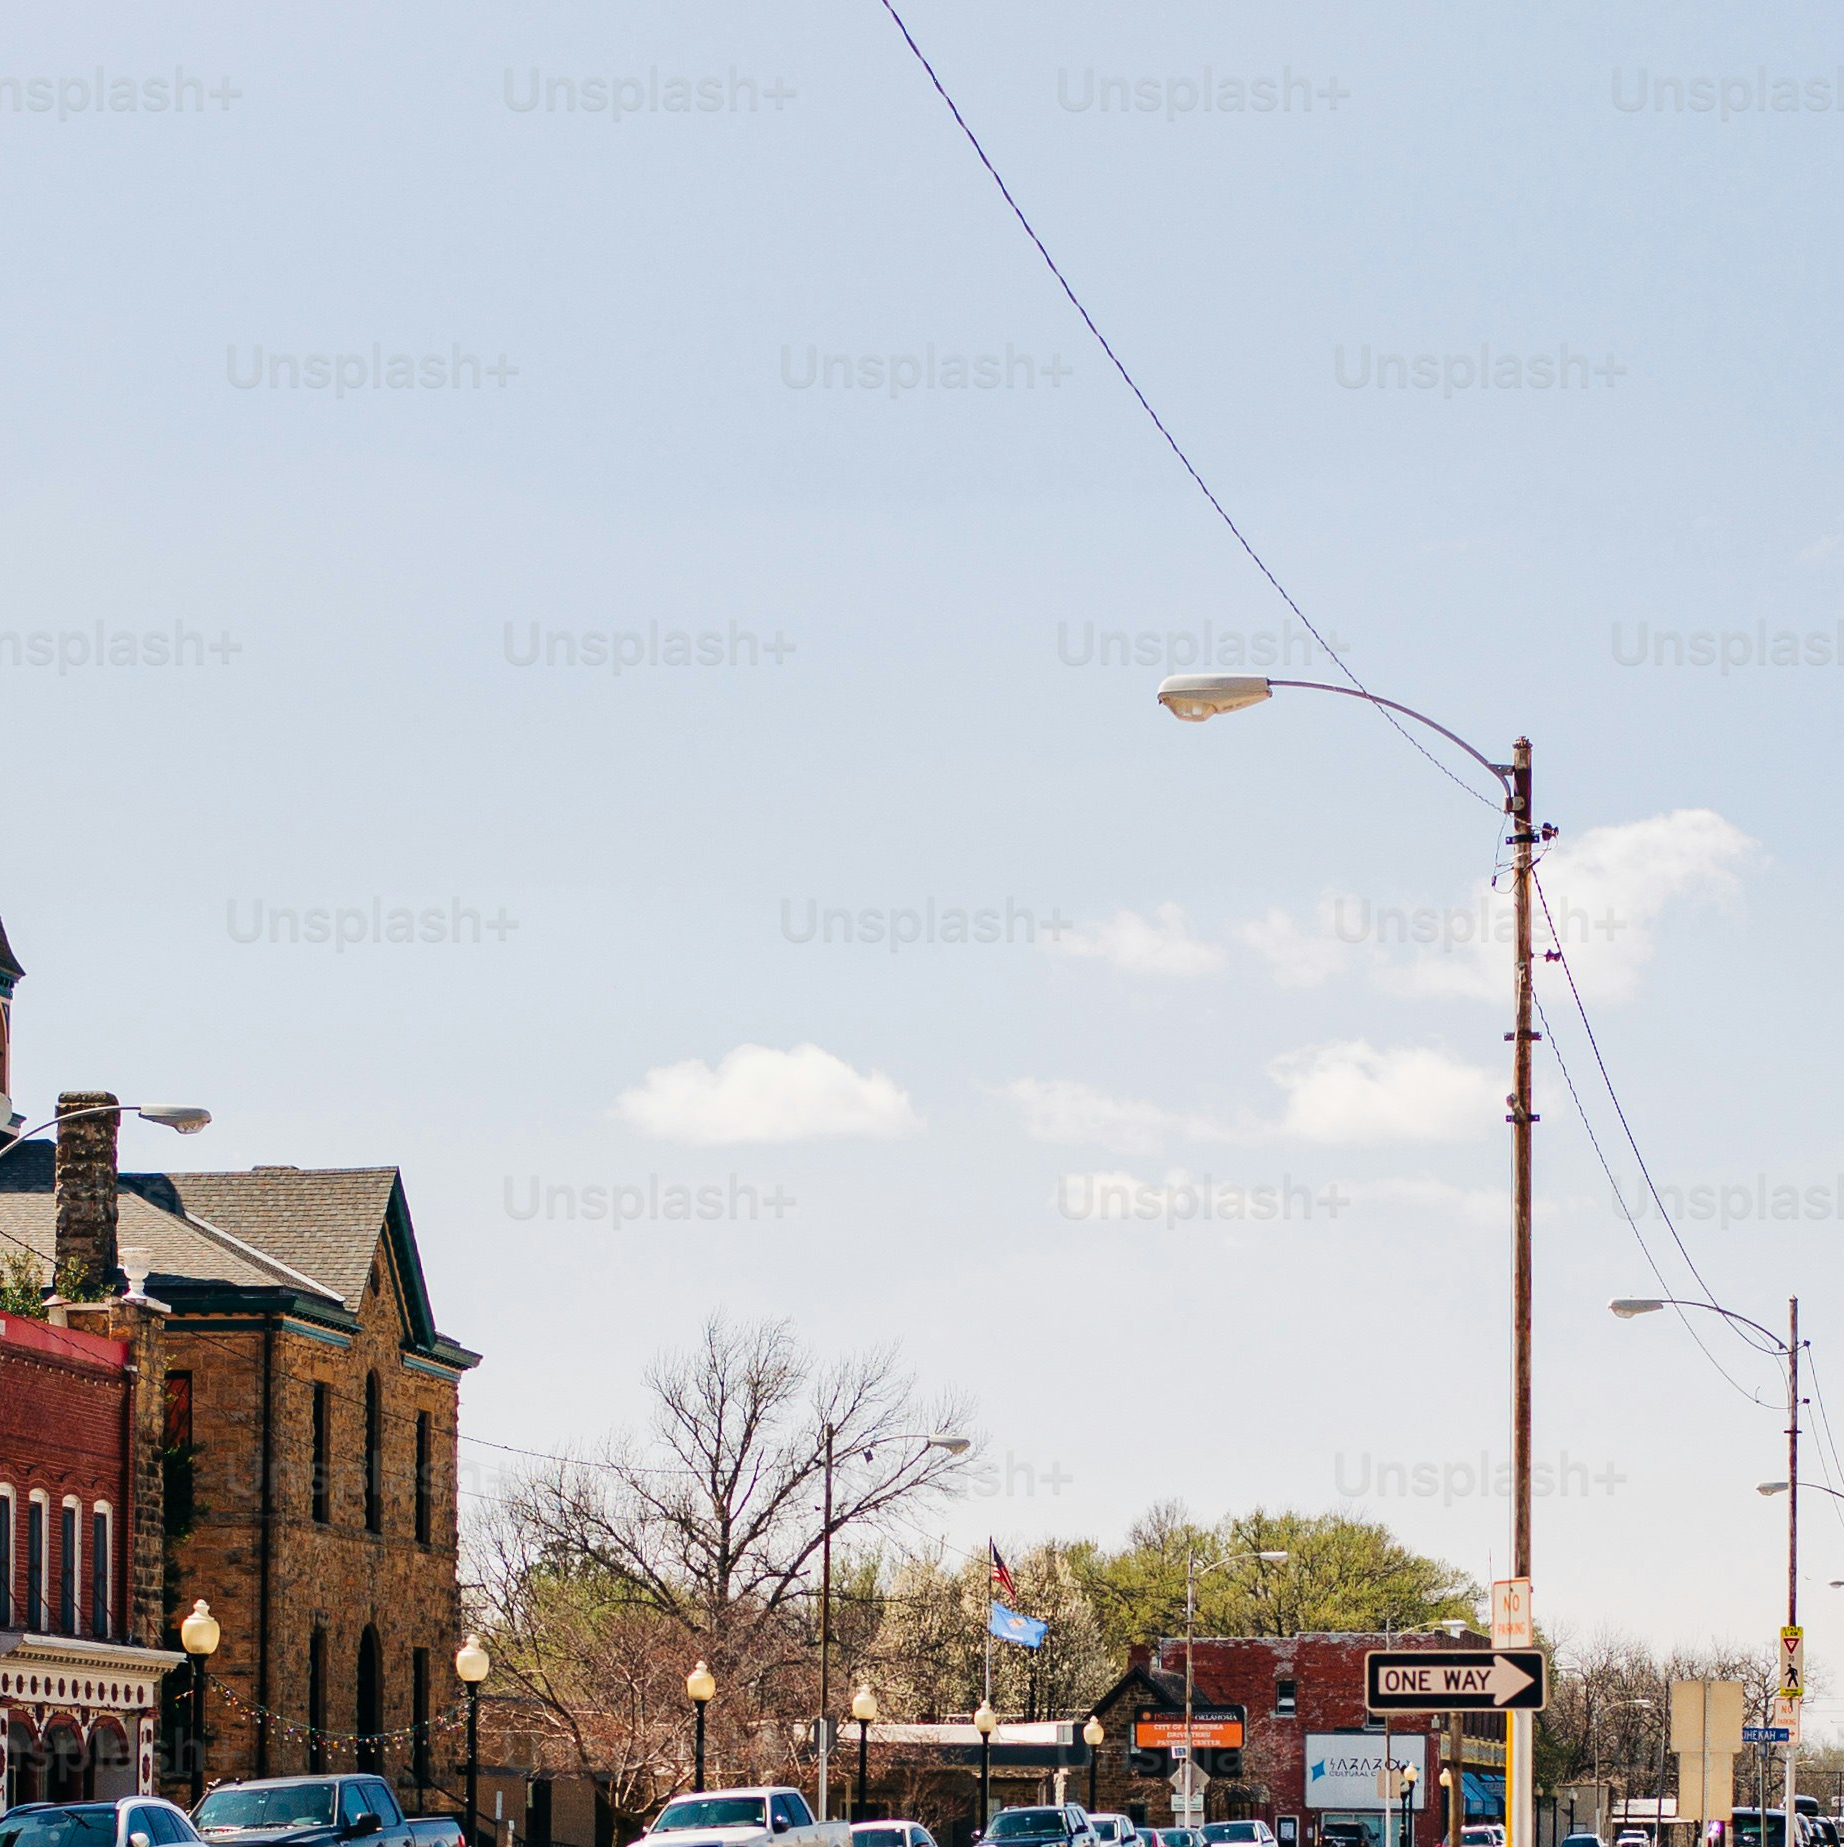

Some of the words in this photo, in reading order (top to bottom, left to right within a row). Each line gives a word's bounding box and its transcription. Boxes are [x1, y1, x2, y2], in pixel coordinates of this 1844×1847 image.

[1503, 1594, 1520, 1613] NO
[1497, 1622, 1526, 1635] PARKING
[1385, 1670, 1431, 1692] ONE
[1443, 1670, 1492, 1691] WAY
[1781, 1704, 1793, 1714] NO
